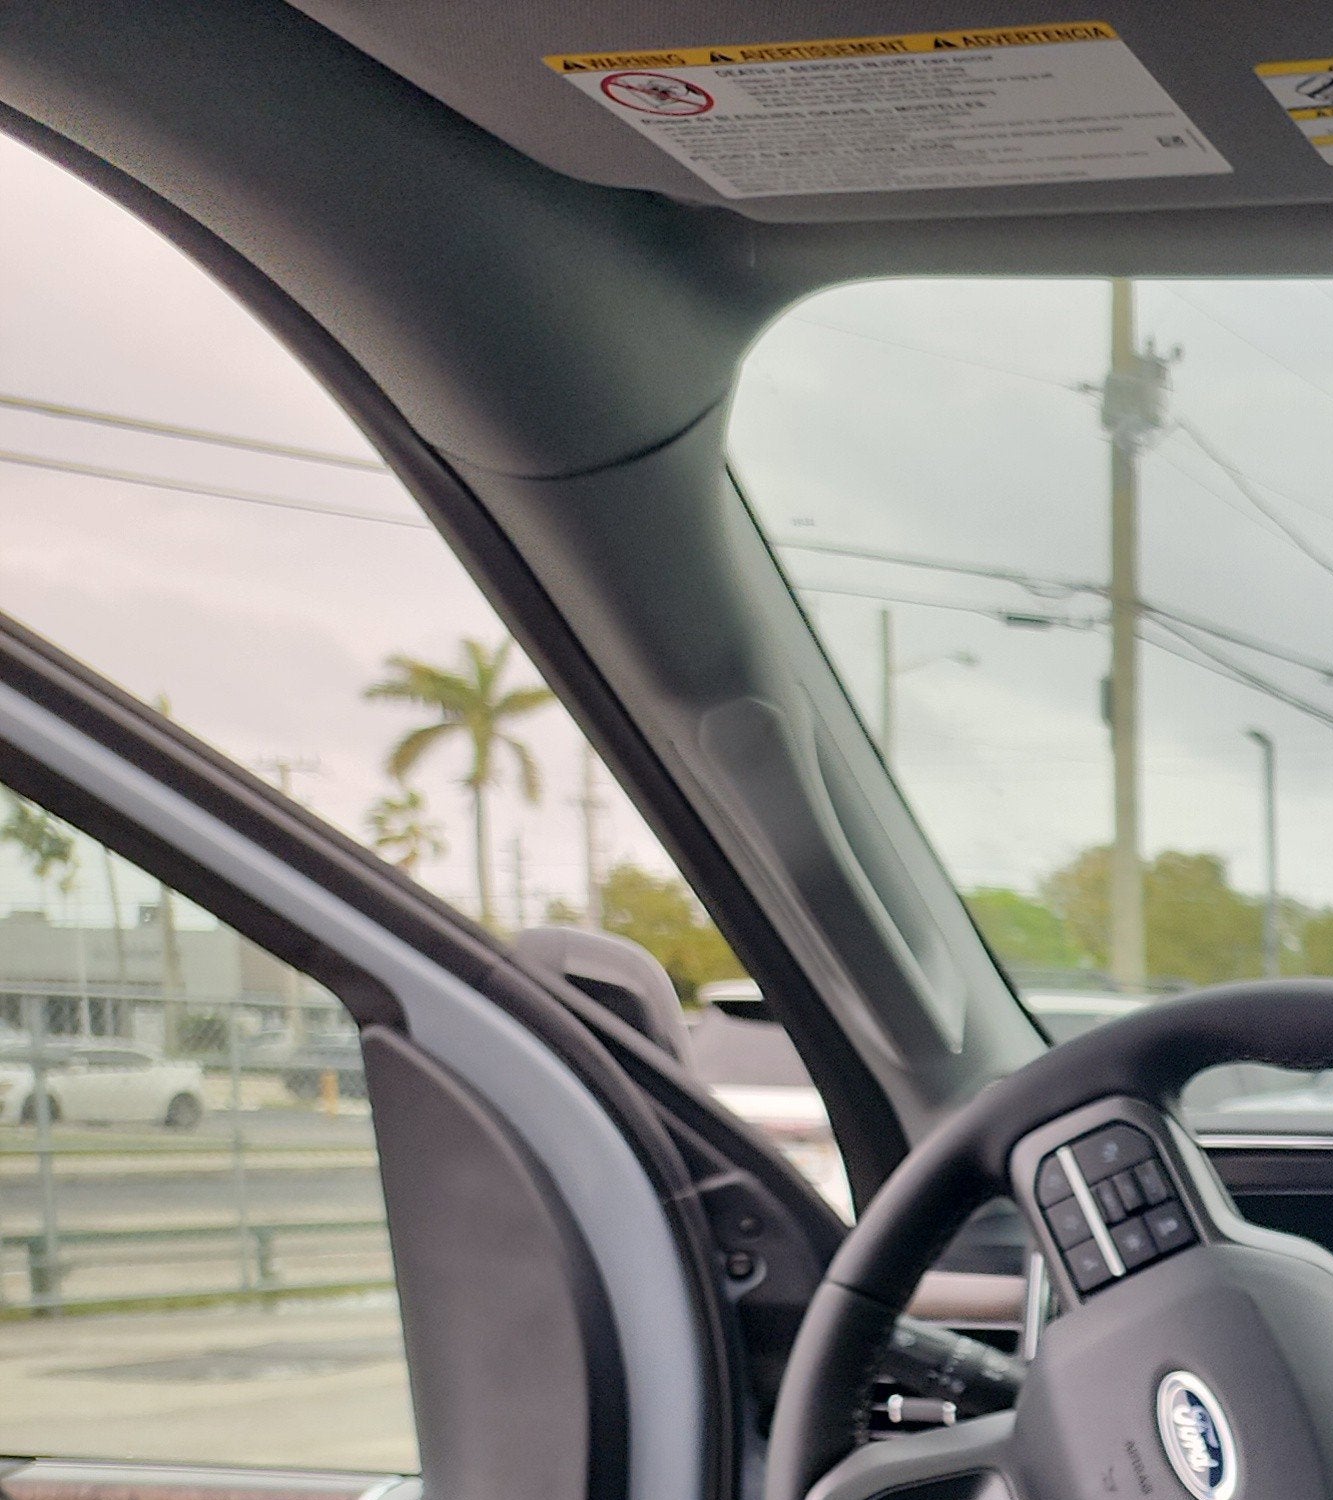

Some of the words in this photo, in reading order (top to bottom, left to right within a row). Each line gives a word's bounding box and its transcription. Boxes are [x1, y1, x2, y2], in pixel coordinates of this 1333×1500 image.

[962, 26, 1107, 48] ADVERTENCIA
[589, 54, 686, 70] WARNING
[739, 39, 908, 63] AVERTISSEMENT
